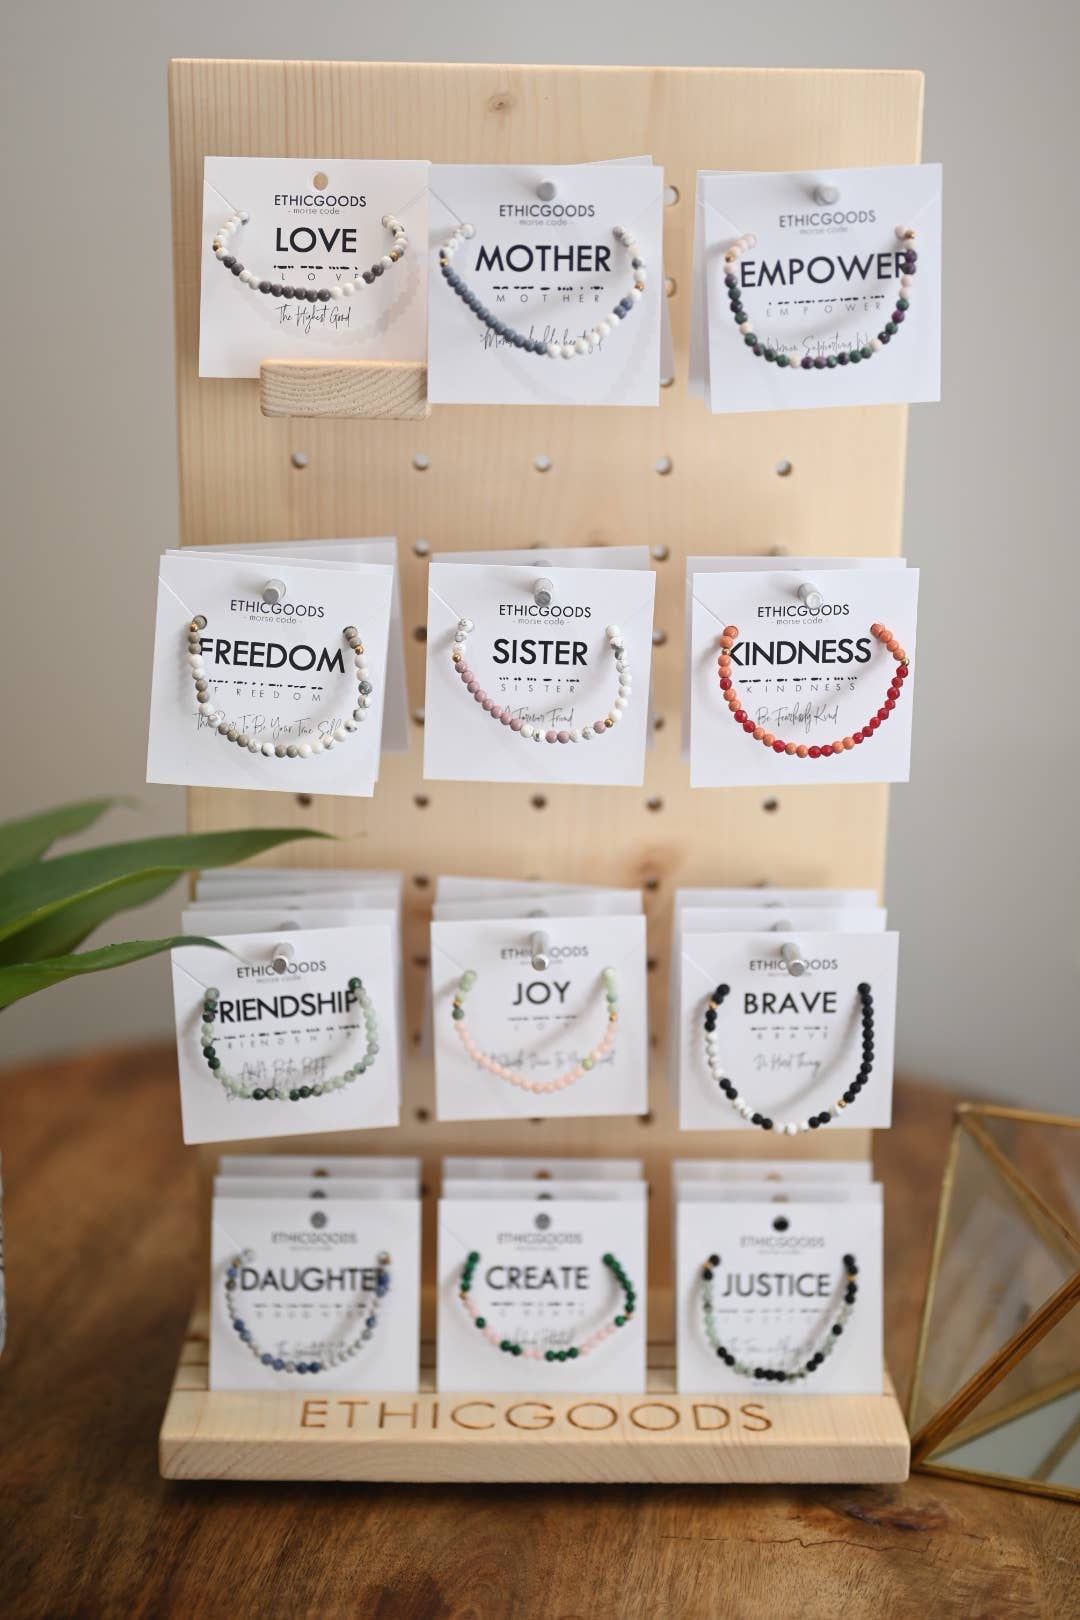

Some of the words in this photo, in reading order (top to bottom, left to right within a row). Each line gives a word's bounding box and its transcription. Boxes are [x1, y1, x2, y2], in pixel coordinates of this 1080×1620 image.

[274, 194, 367, 207] ETHICGOODS
[319, 207, 340, 215] code
[499, 204, 595, 217] ETHICGOODS
[779, 210, 876, 228] ETHICGOODS
[275, 227, 357, 253] LOVE
[475, 244, 611, 272] MOTHER
[276, 304, 292, 324] The
[295, 305, 328, 334] Highest
[328, 306, 351, 327] Good
[230, 599, 325, 618] ETHICGOODS
[499, 604, 592, 618] ETHICGOODS
[249, 615, 274, 623] morse
[275, 617, 297, 625] code
[492, 638, 588, 666] SISTER
[500, 946, 589, 960] ETHIOODS
[237, 961, 327, 978] ETHICOODS
[513, 981, 571, 1006] JOY
[744, 992, 837, 1014] BRAVE
[213, 990, 360, 1023] RIENDSHIP
[485, 1266, 590, 1290] CREATE
[722, 1273, 832, 1297] JUSTICE
[299, 1400, 773, 1432] ETHICGOODS
